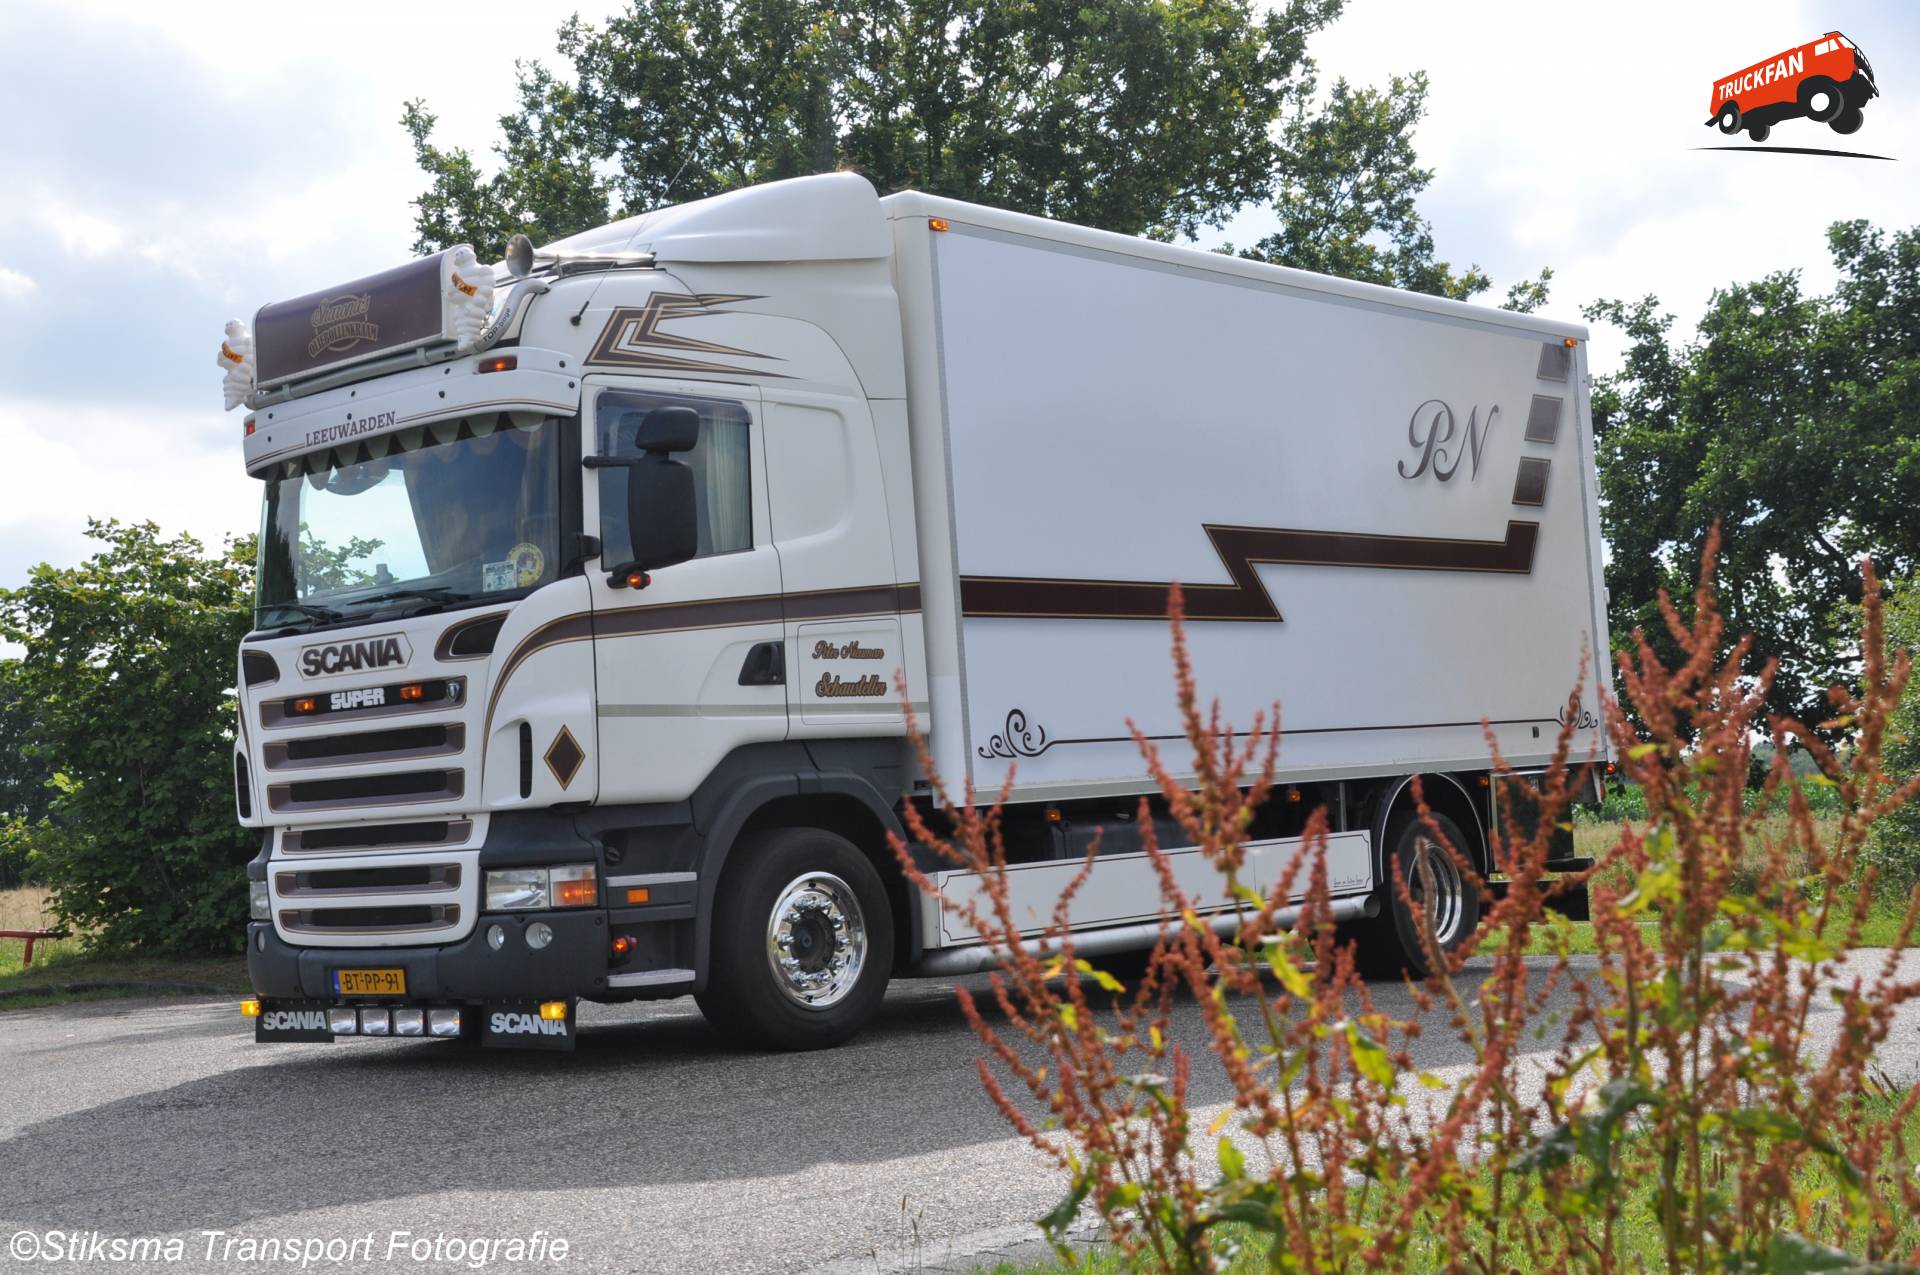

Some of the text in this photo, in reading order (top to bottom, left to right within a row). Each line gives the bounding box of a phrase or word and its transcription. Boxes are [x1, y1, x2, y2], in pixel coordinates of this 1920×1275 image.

[305, 411, 396, 447] LEEUWARDEN
[1398, 399, 1499, 482] PN
[302, 637, 404, 677] SCANIA
[330, 687, 385, 711] SUPER
[263, 1011, 327, 1030] SCANIA
[490, 1012, 568, 1036] SCANIA
